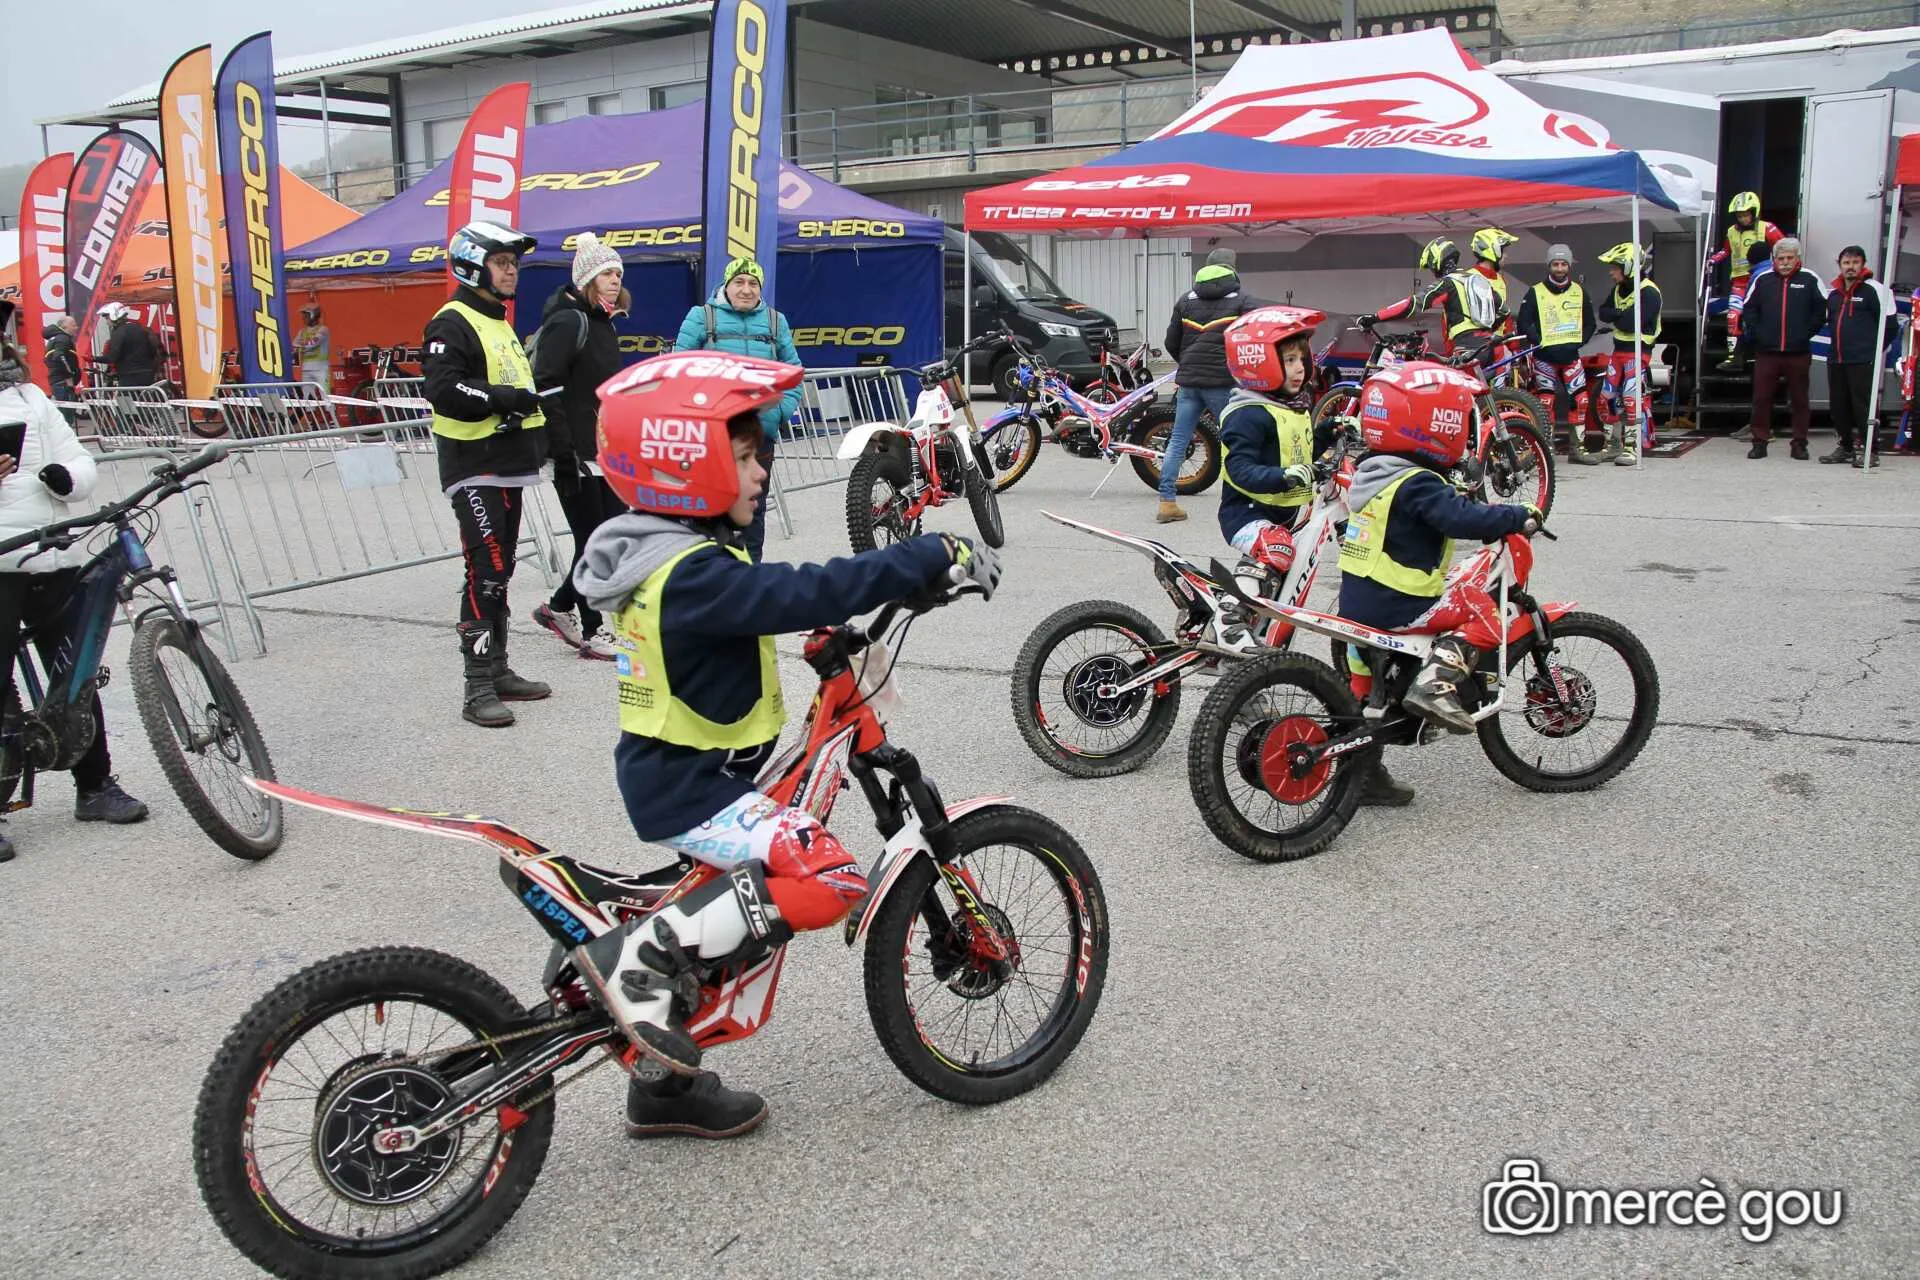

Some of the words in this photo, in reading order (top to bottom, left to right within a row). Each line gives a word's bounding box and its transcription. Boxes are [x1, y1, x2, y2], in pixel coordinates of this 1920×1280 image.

[728, 0, 767, 260] ERCO
[470, 125, 518, 228] TUL
[1022, 173, 1191, 191] Beta
[73, 142, 148, 291] COMAS
[177, 94, 218, 375] SCORPA
[235, 81, 284, 378] SHERCO
[798, 219, 905, 238] SHERCO
[33, 187, 68, 340] OTUL
[284, 250, 390, 271] SHERCO
[794, 326, 906, 346] ERCO
[1236, 343, 1265, 356] NON
[1432, 407, 1463, 424] NON
[640, 417, 707, 443] NON
[464, 484, 494, 538] AGONA
[657, 493, 708, 511] SPEA
[1335, 735, 1373, 753] Beta
[620, 895, 644, 906] TRS
[546, 900, 589, 943] SPEA
